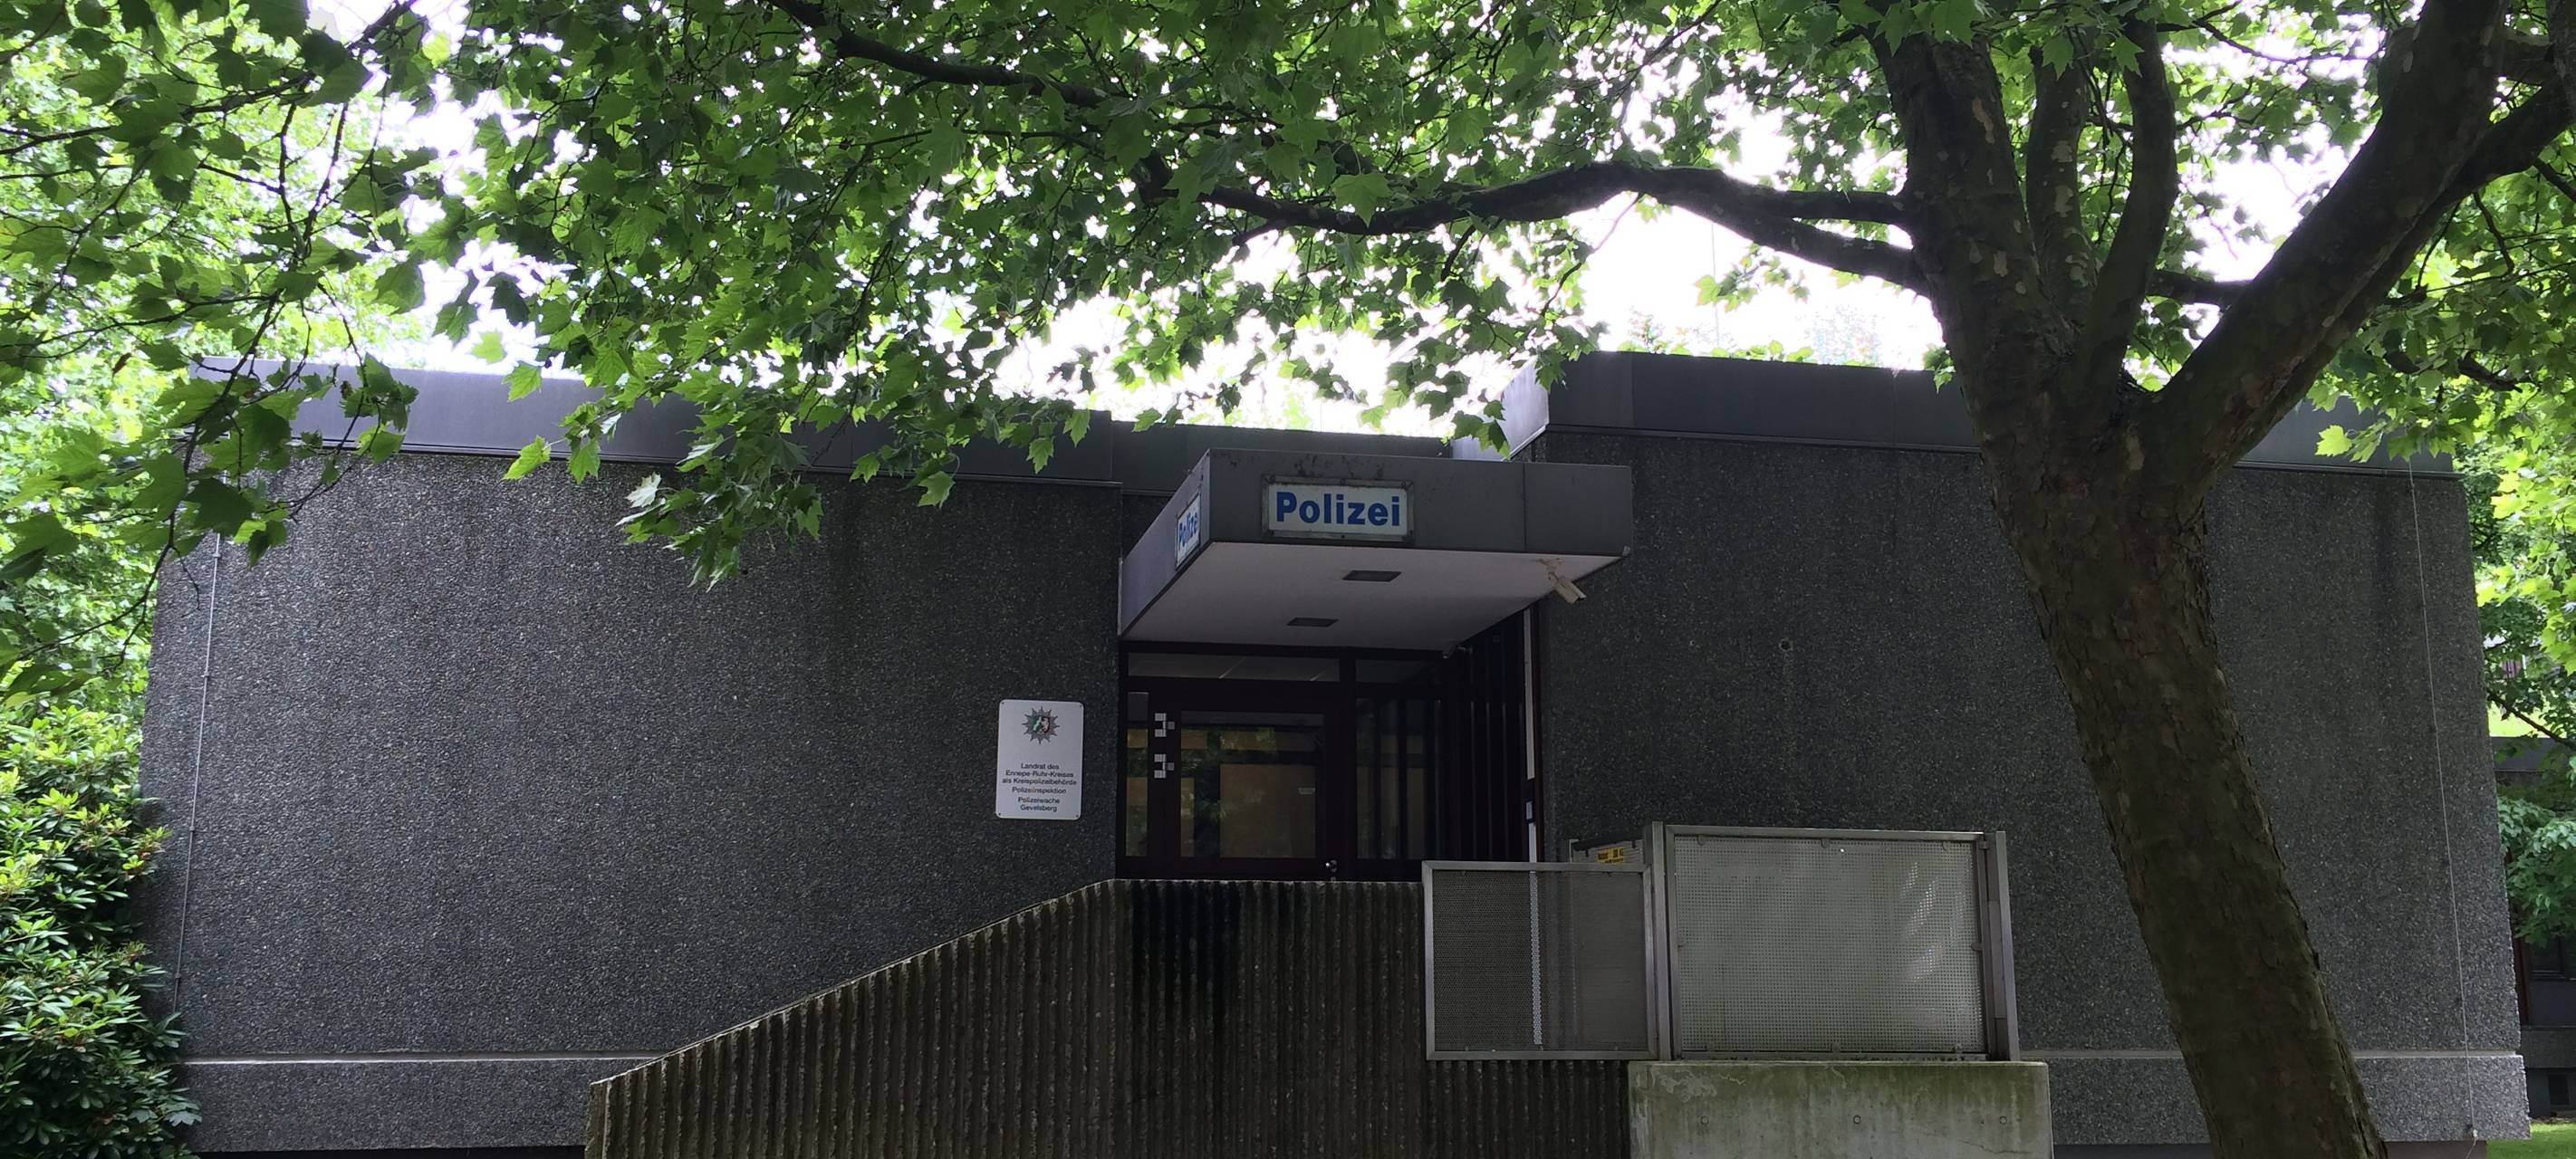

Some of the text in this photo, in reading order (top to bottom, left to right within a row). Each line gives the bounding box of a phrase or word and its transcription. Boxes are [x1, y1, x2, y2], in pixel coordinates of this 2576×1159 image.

[1276, 492, 1400, 526] Polizei
[1179, 512, 1197, 547] Polize
[1005, 770, 1074, 778] Ennepe-Ruhr-Kreises
[1012, 786, 1066, 794] Polizeiinspektion
[1021, 804, 1057, 812] Gevelsberg
